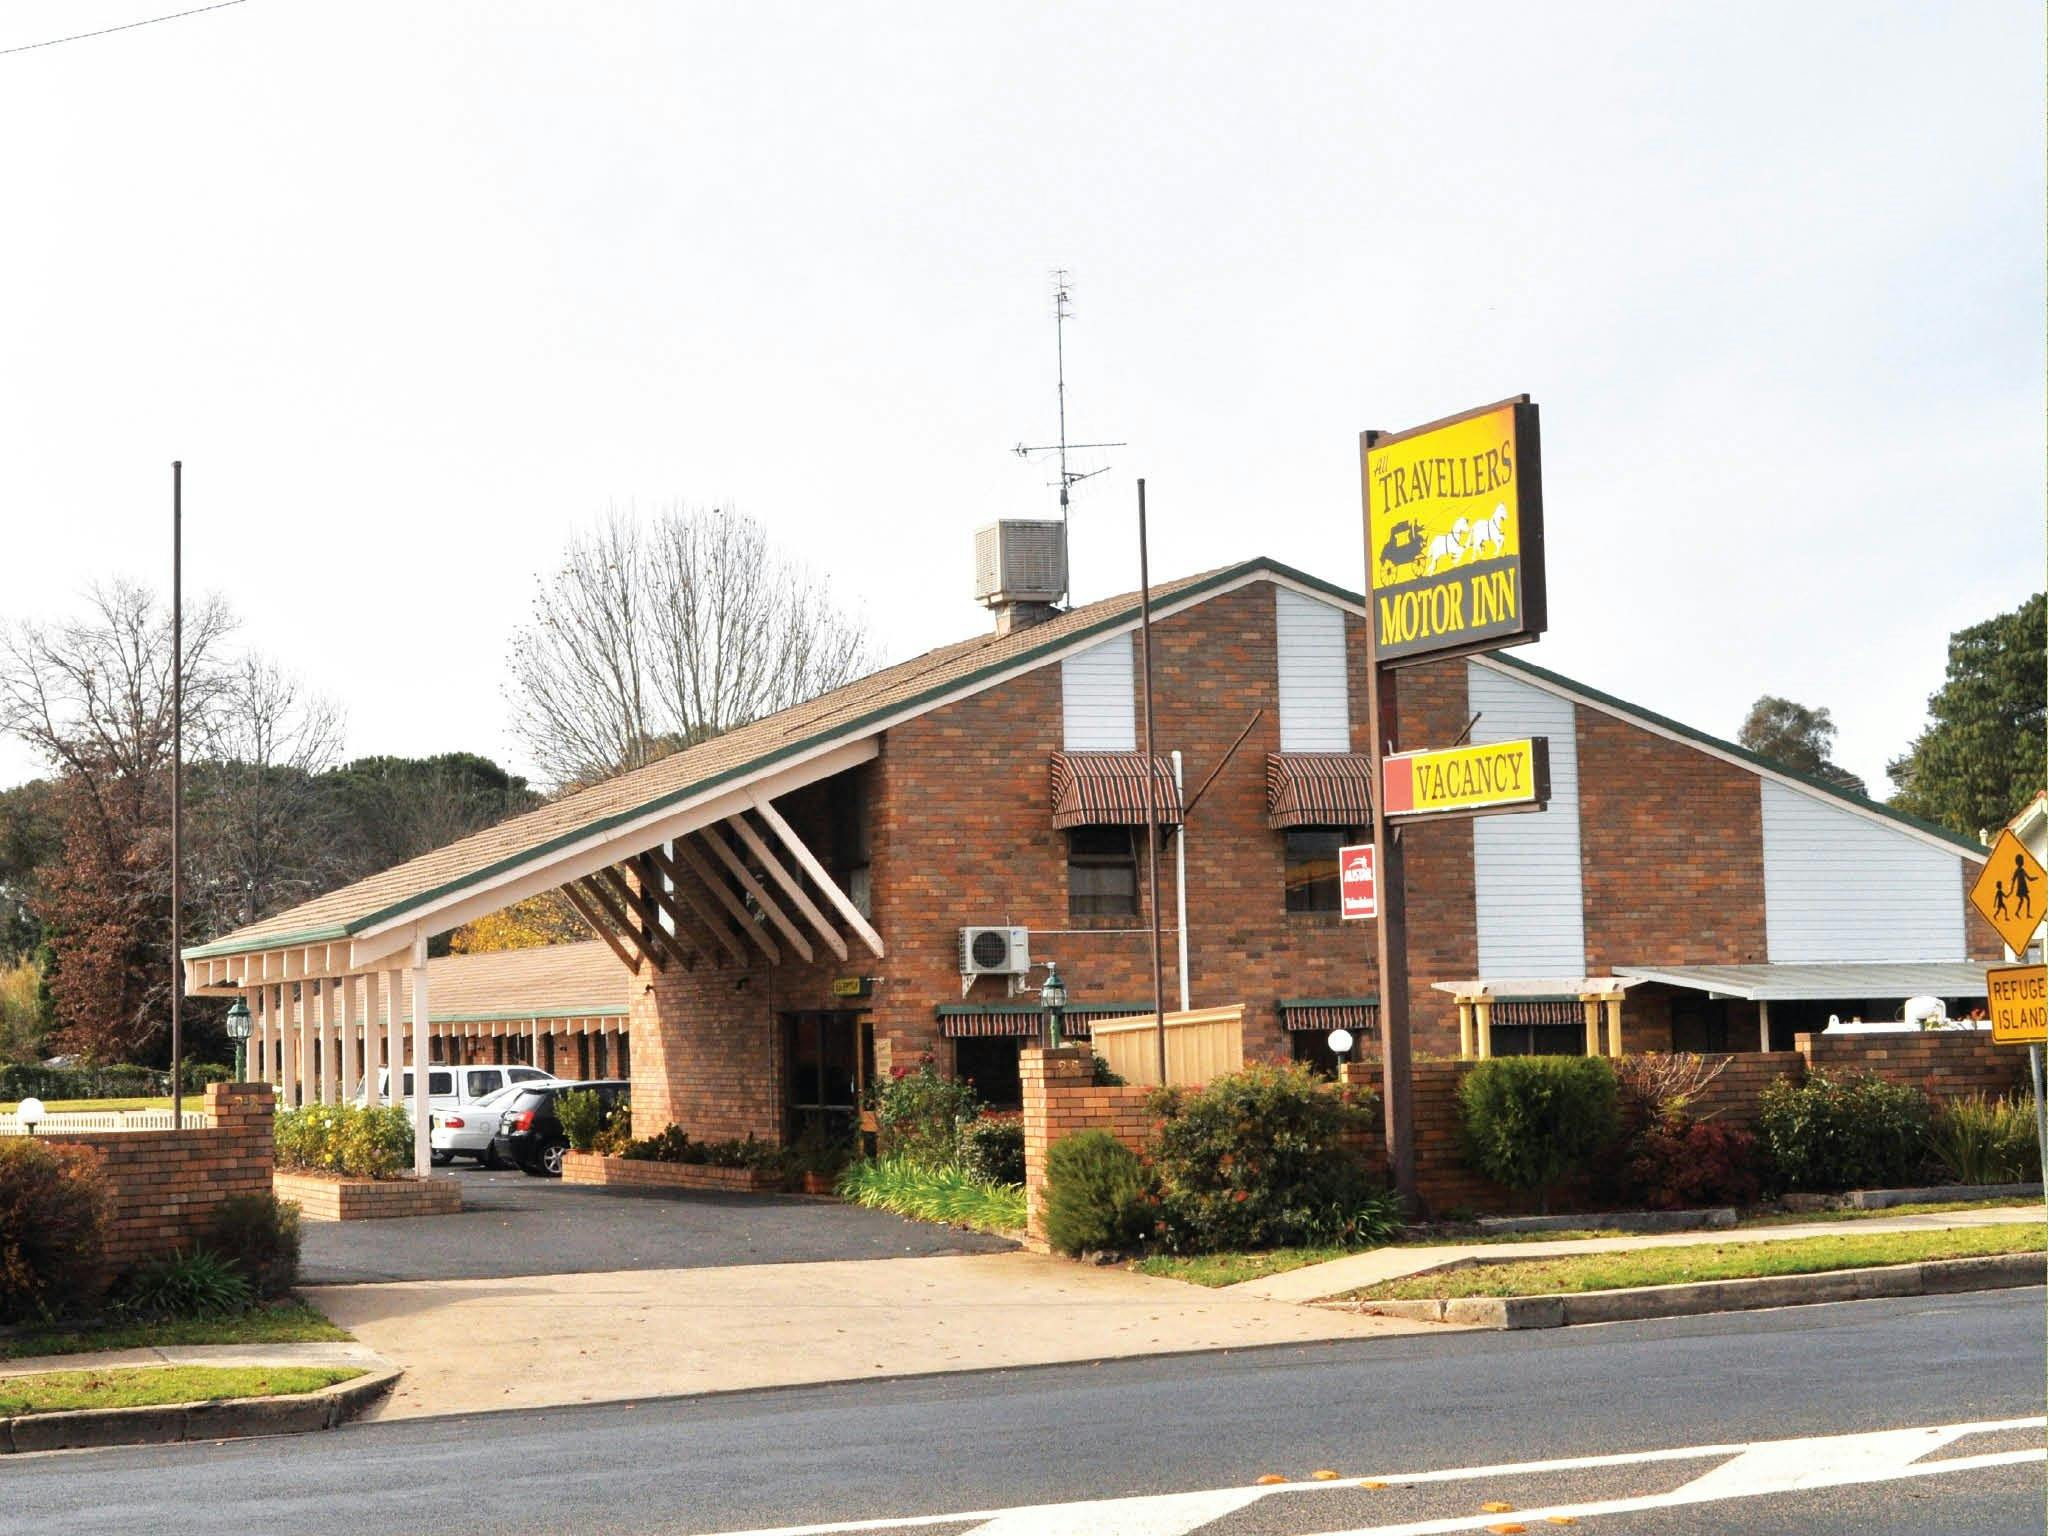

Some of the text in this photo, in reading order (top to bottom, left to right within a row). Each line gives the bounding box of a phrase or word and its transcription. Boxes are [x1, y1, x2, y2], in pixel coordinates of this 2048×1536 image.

[1379, 440, 1512, 514] TRAVELLERS
[1380, 567, 1516, 645] MOTOR INN
[1416, 752, 1523, 800] VACANCY
[1993, 977, 2046, 1000] REFUGE
[1998, 1006, 2047, 1029] ISLAND
